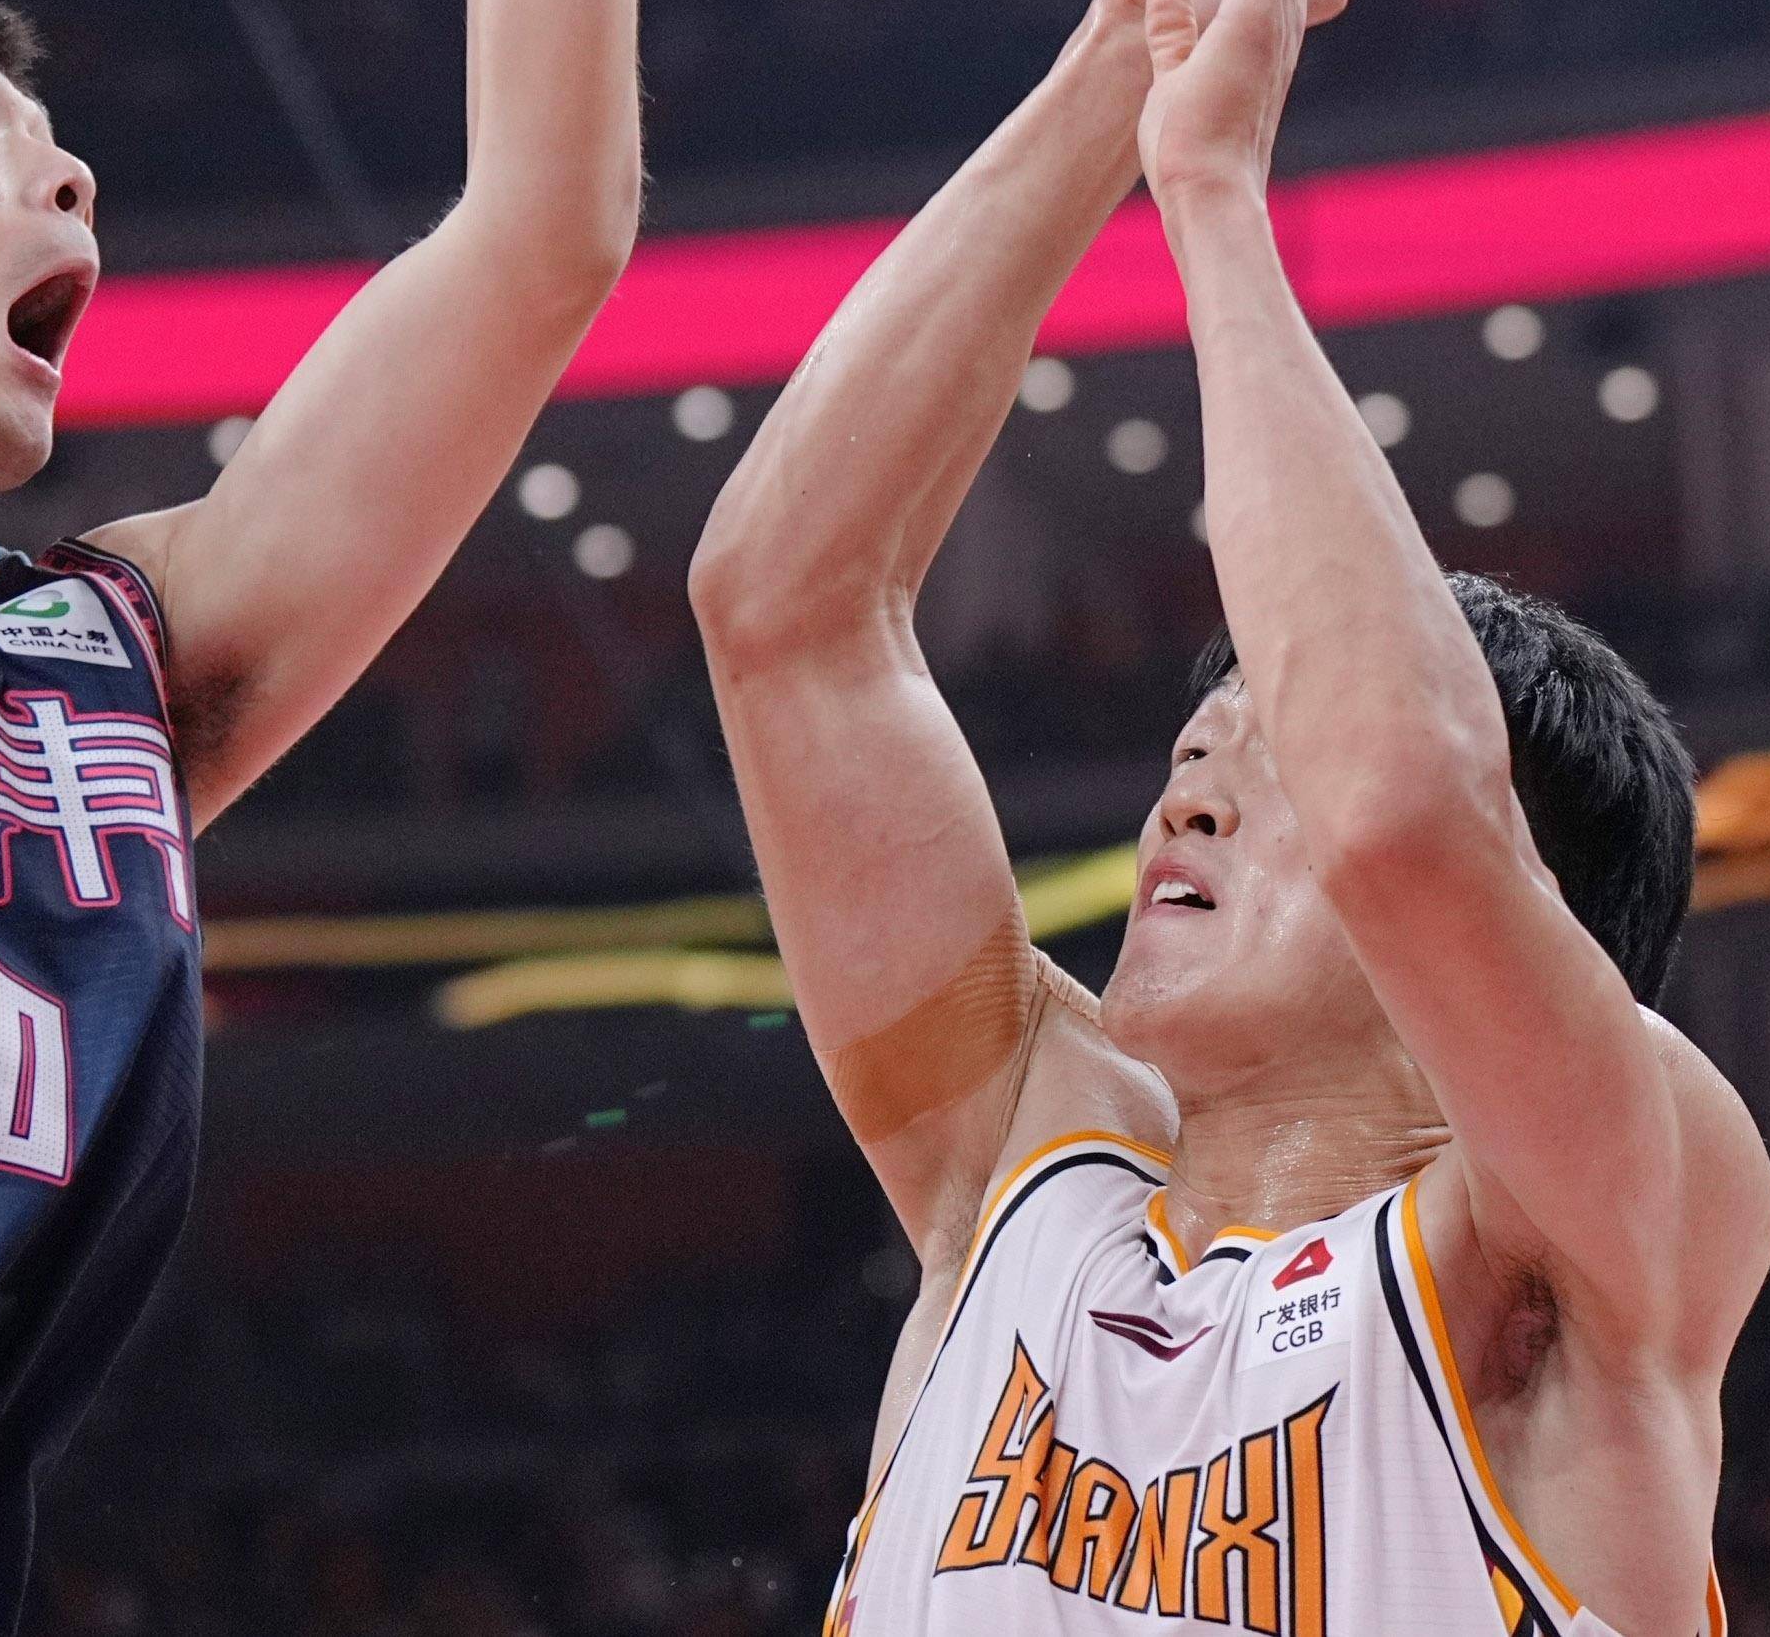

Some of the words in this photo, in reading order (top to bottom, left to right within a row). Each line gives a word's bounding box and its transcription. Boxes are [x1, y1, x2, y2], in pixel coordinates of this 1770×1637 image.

[8, 639, 70, 650] CHINA
[75, 643, 115, 656] LIFE
[1256, 1286, 1341, 1334] 广发银行
[1272, 1320, 1324, 1353] CGB
[934, 1329, 1341, 1637] SHANXI
